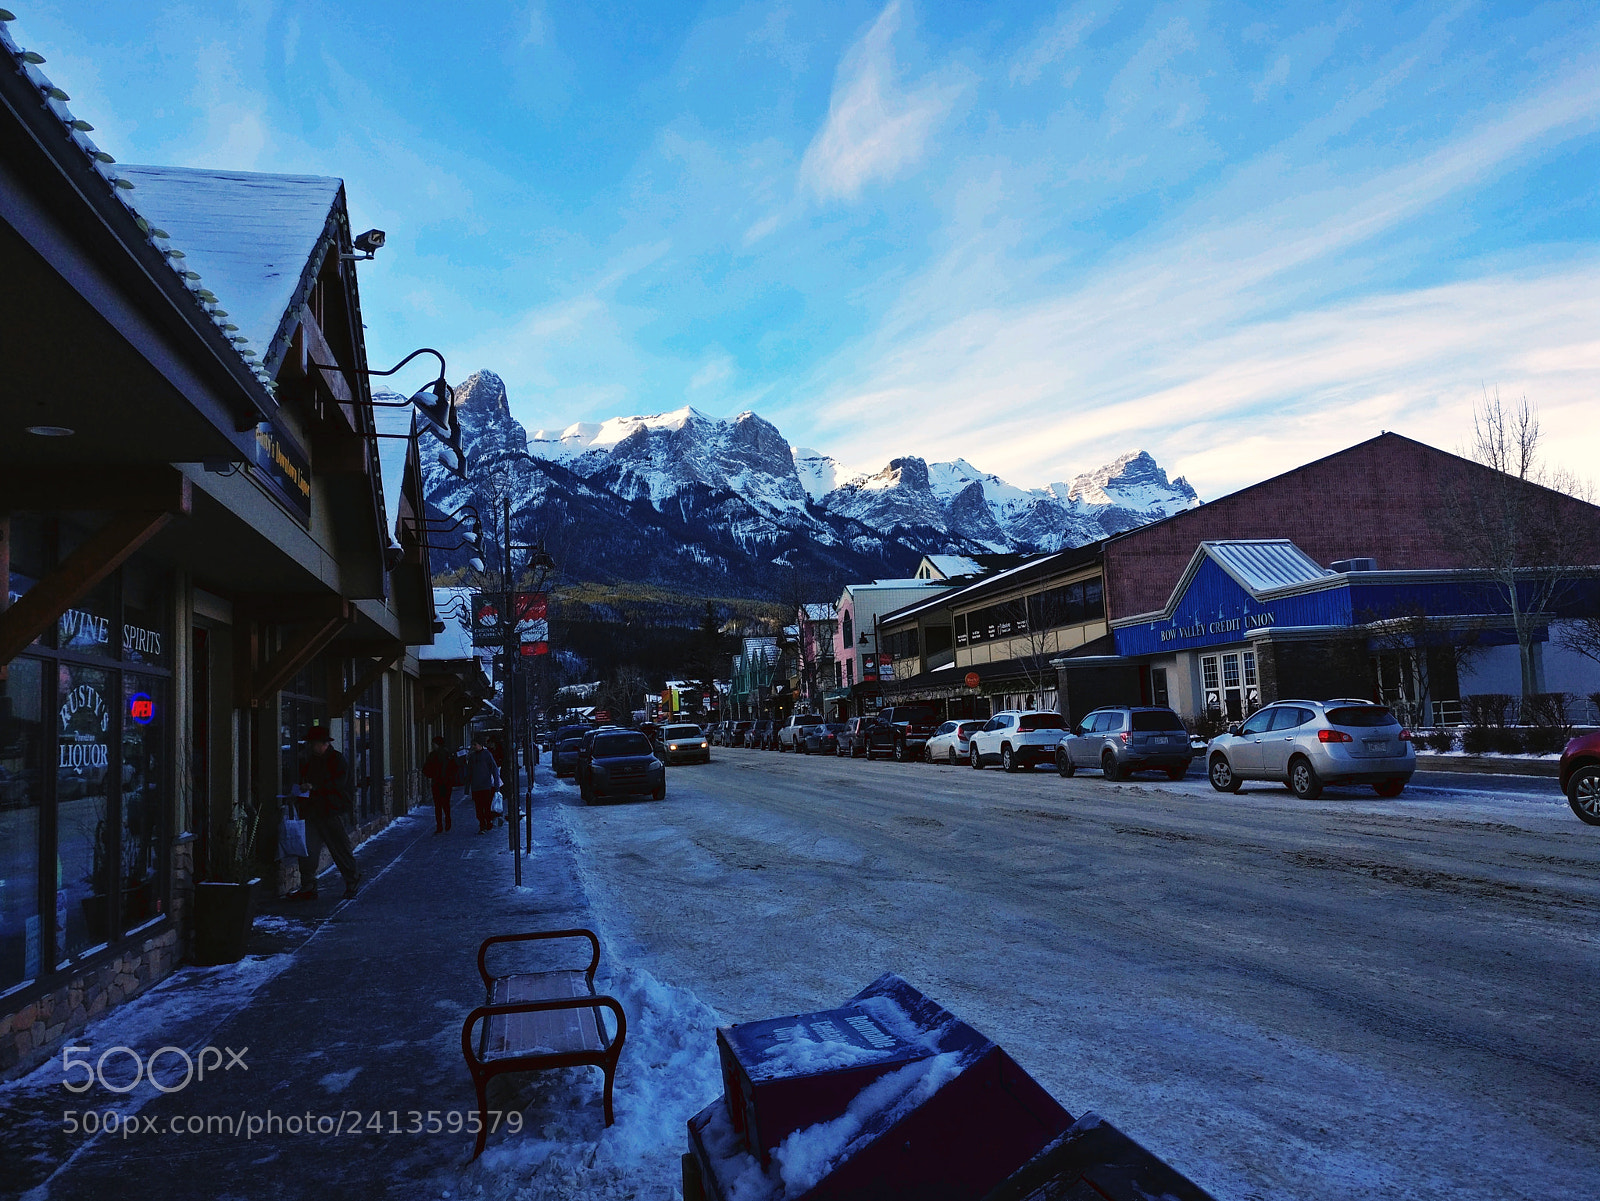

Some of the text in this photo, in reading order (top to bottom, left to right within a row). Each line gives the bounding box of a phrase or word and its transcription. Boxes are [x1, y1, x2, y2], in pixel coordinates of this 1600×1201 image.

[61, 608, 109, 644] WINE
[123, 623, 161, 655] SPIRITS
[1160, 611, 1275, 642] BOW VALLEY CREDIT UNION
[59, 684, 109, 732] RUSTY'S
[59, 744, 109, 775] LIQUOR
